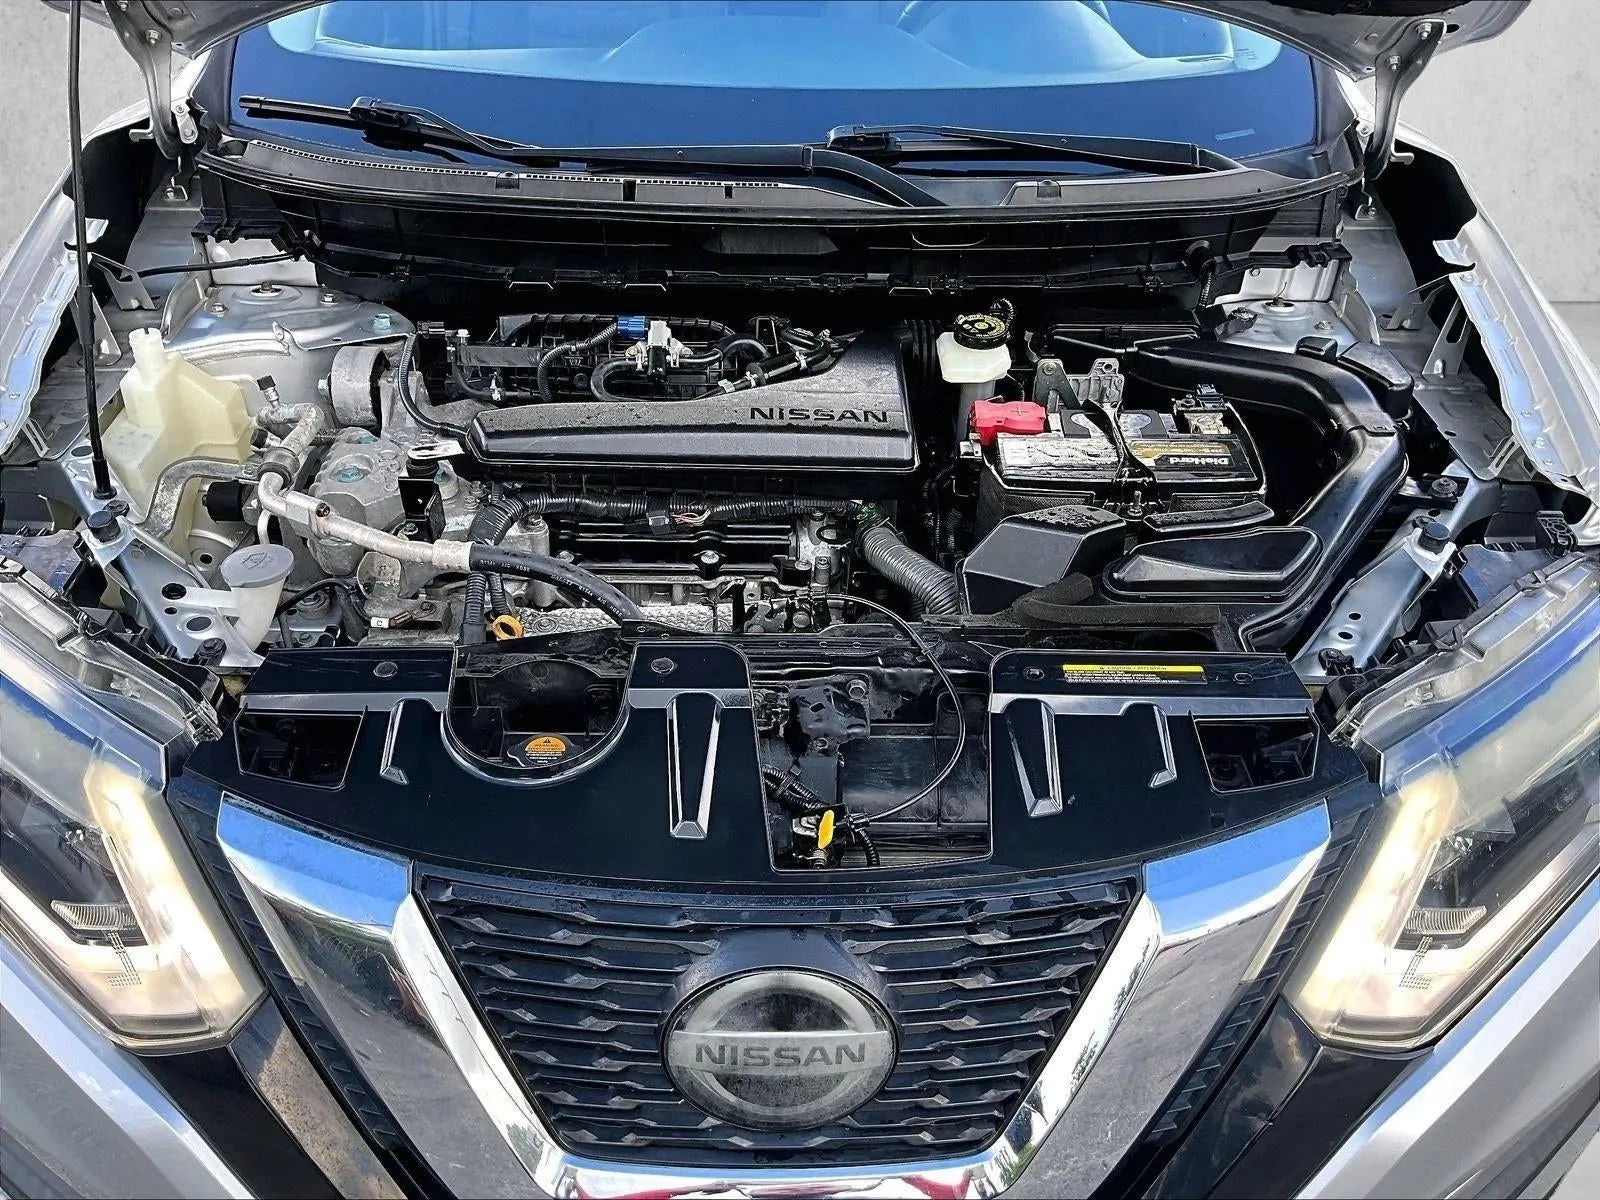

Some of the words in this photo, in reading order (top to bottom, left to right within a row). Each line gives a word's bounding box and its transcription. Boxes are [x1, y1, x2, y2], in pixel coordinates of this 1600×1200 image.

[750, 406, 888, 423] NISSAN
[1169, 457, 1229, 465] DieHard
[695, 1041, 866, 1067] NISSAN
